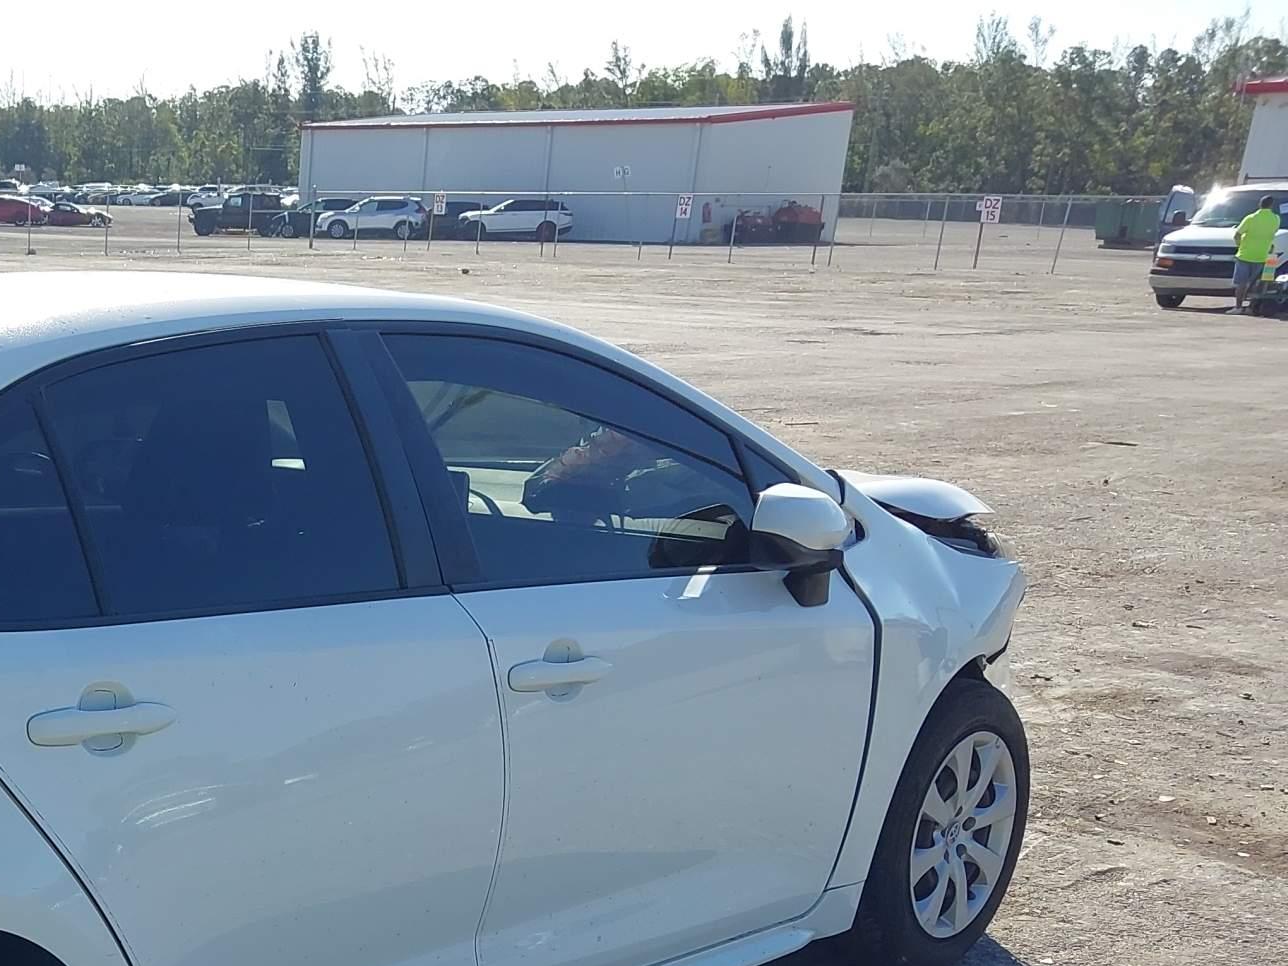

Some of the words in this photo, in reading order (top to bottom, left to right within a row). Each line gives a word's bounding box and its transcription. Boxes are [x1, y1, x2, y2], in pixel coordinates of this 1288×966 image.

[679, 196, 692, 207] DZ
[984, 198, 1000, 210] DZ
[679, 207, 688, 217] 14
[986, 210, 996, 221] 15
